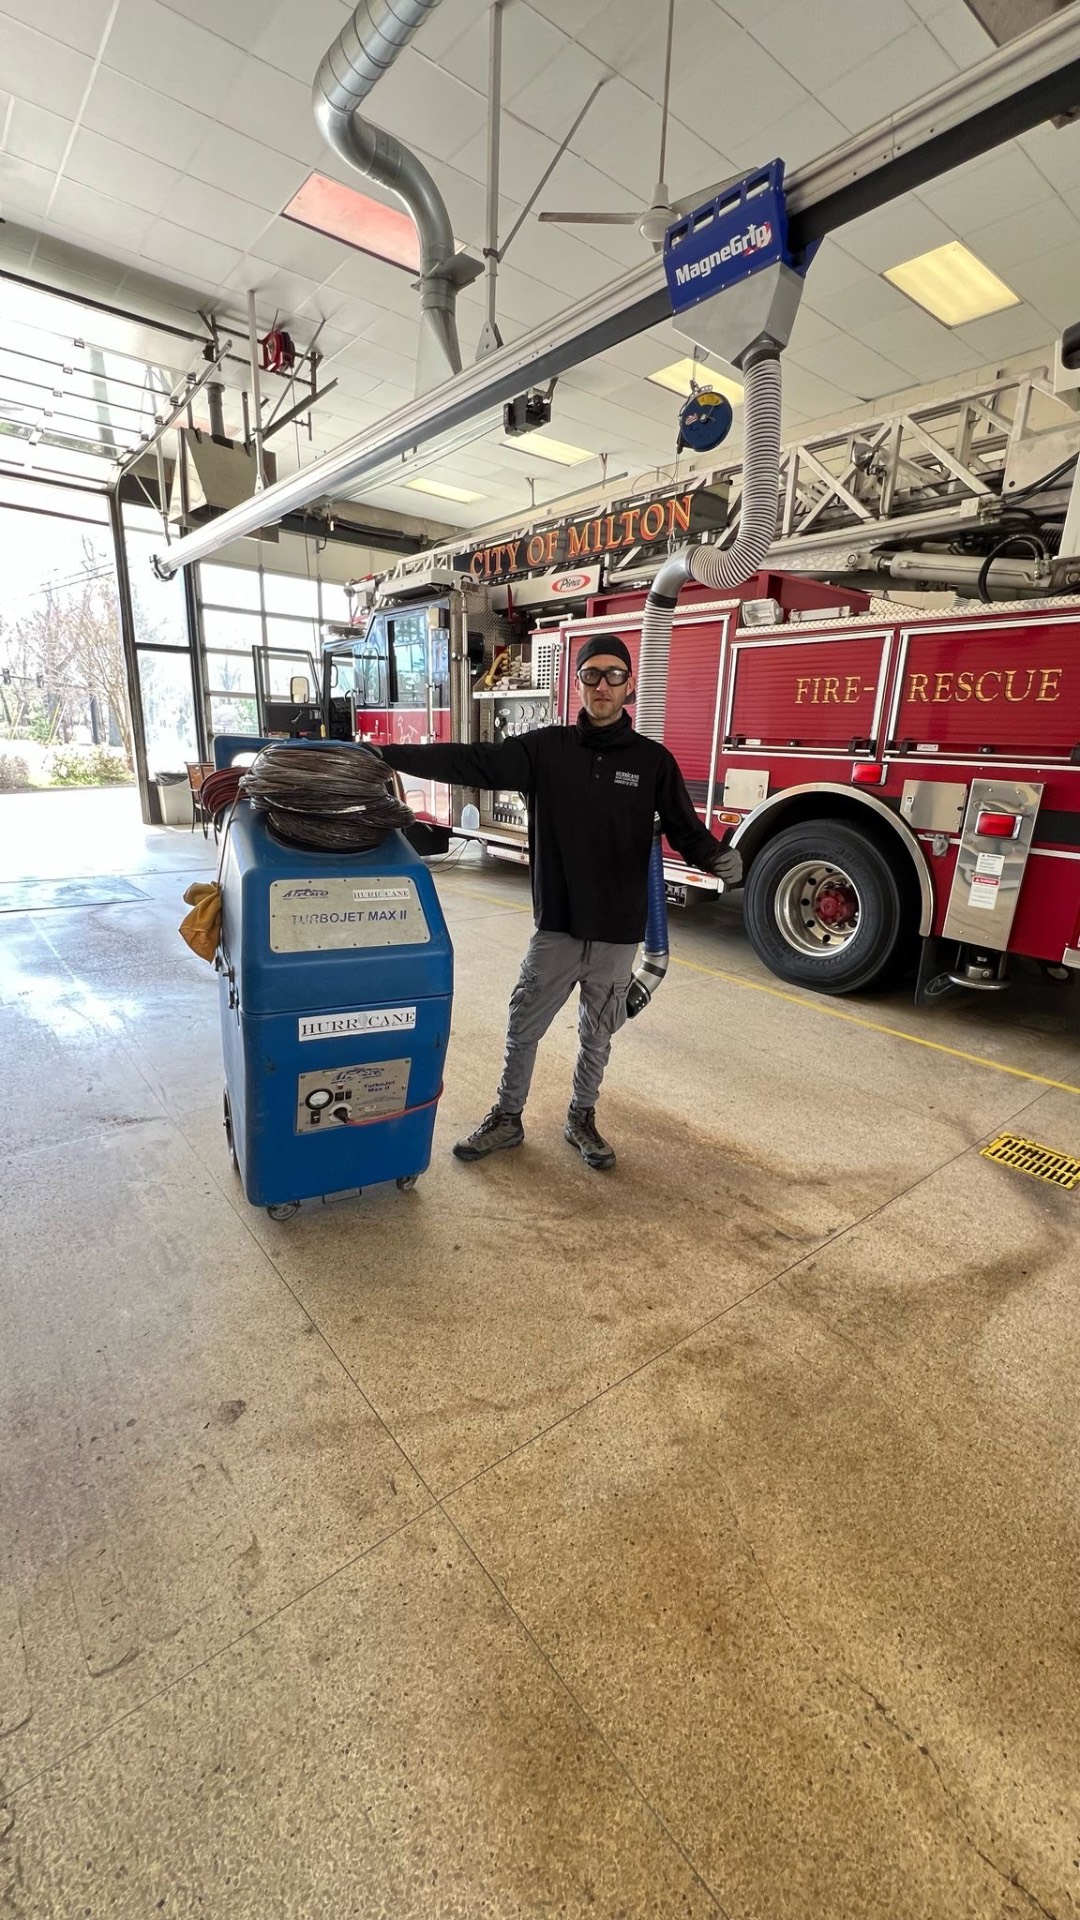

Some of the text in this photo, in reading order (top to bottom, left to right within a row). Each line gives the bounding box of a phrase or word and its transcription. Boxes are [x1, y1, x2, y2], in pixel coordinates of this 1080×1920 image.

[675, 223, 772, 286] MagneGrip
[469, 494, 694, 578] CITY OF MILTON
[560, 578, 581, 590] Pierce
[906, 668, 1063, 703] RESCUE
[292, 910, 407, 925] TURBOJET MAX II
[301, 1012, 415, 1036] HURRICANE
